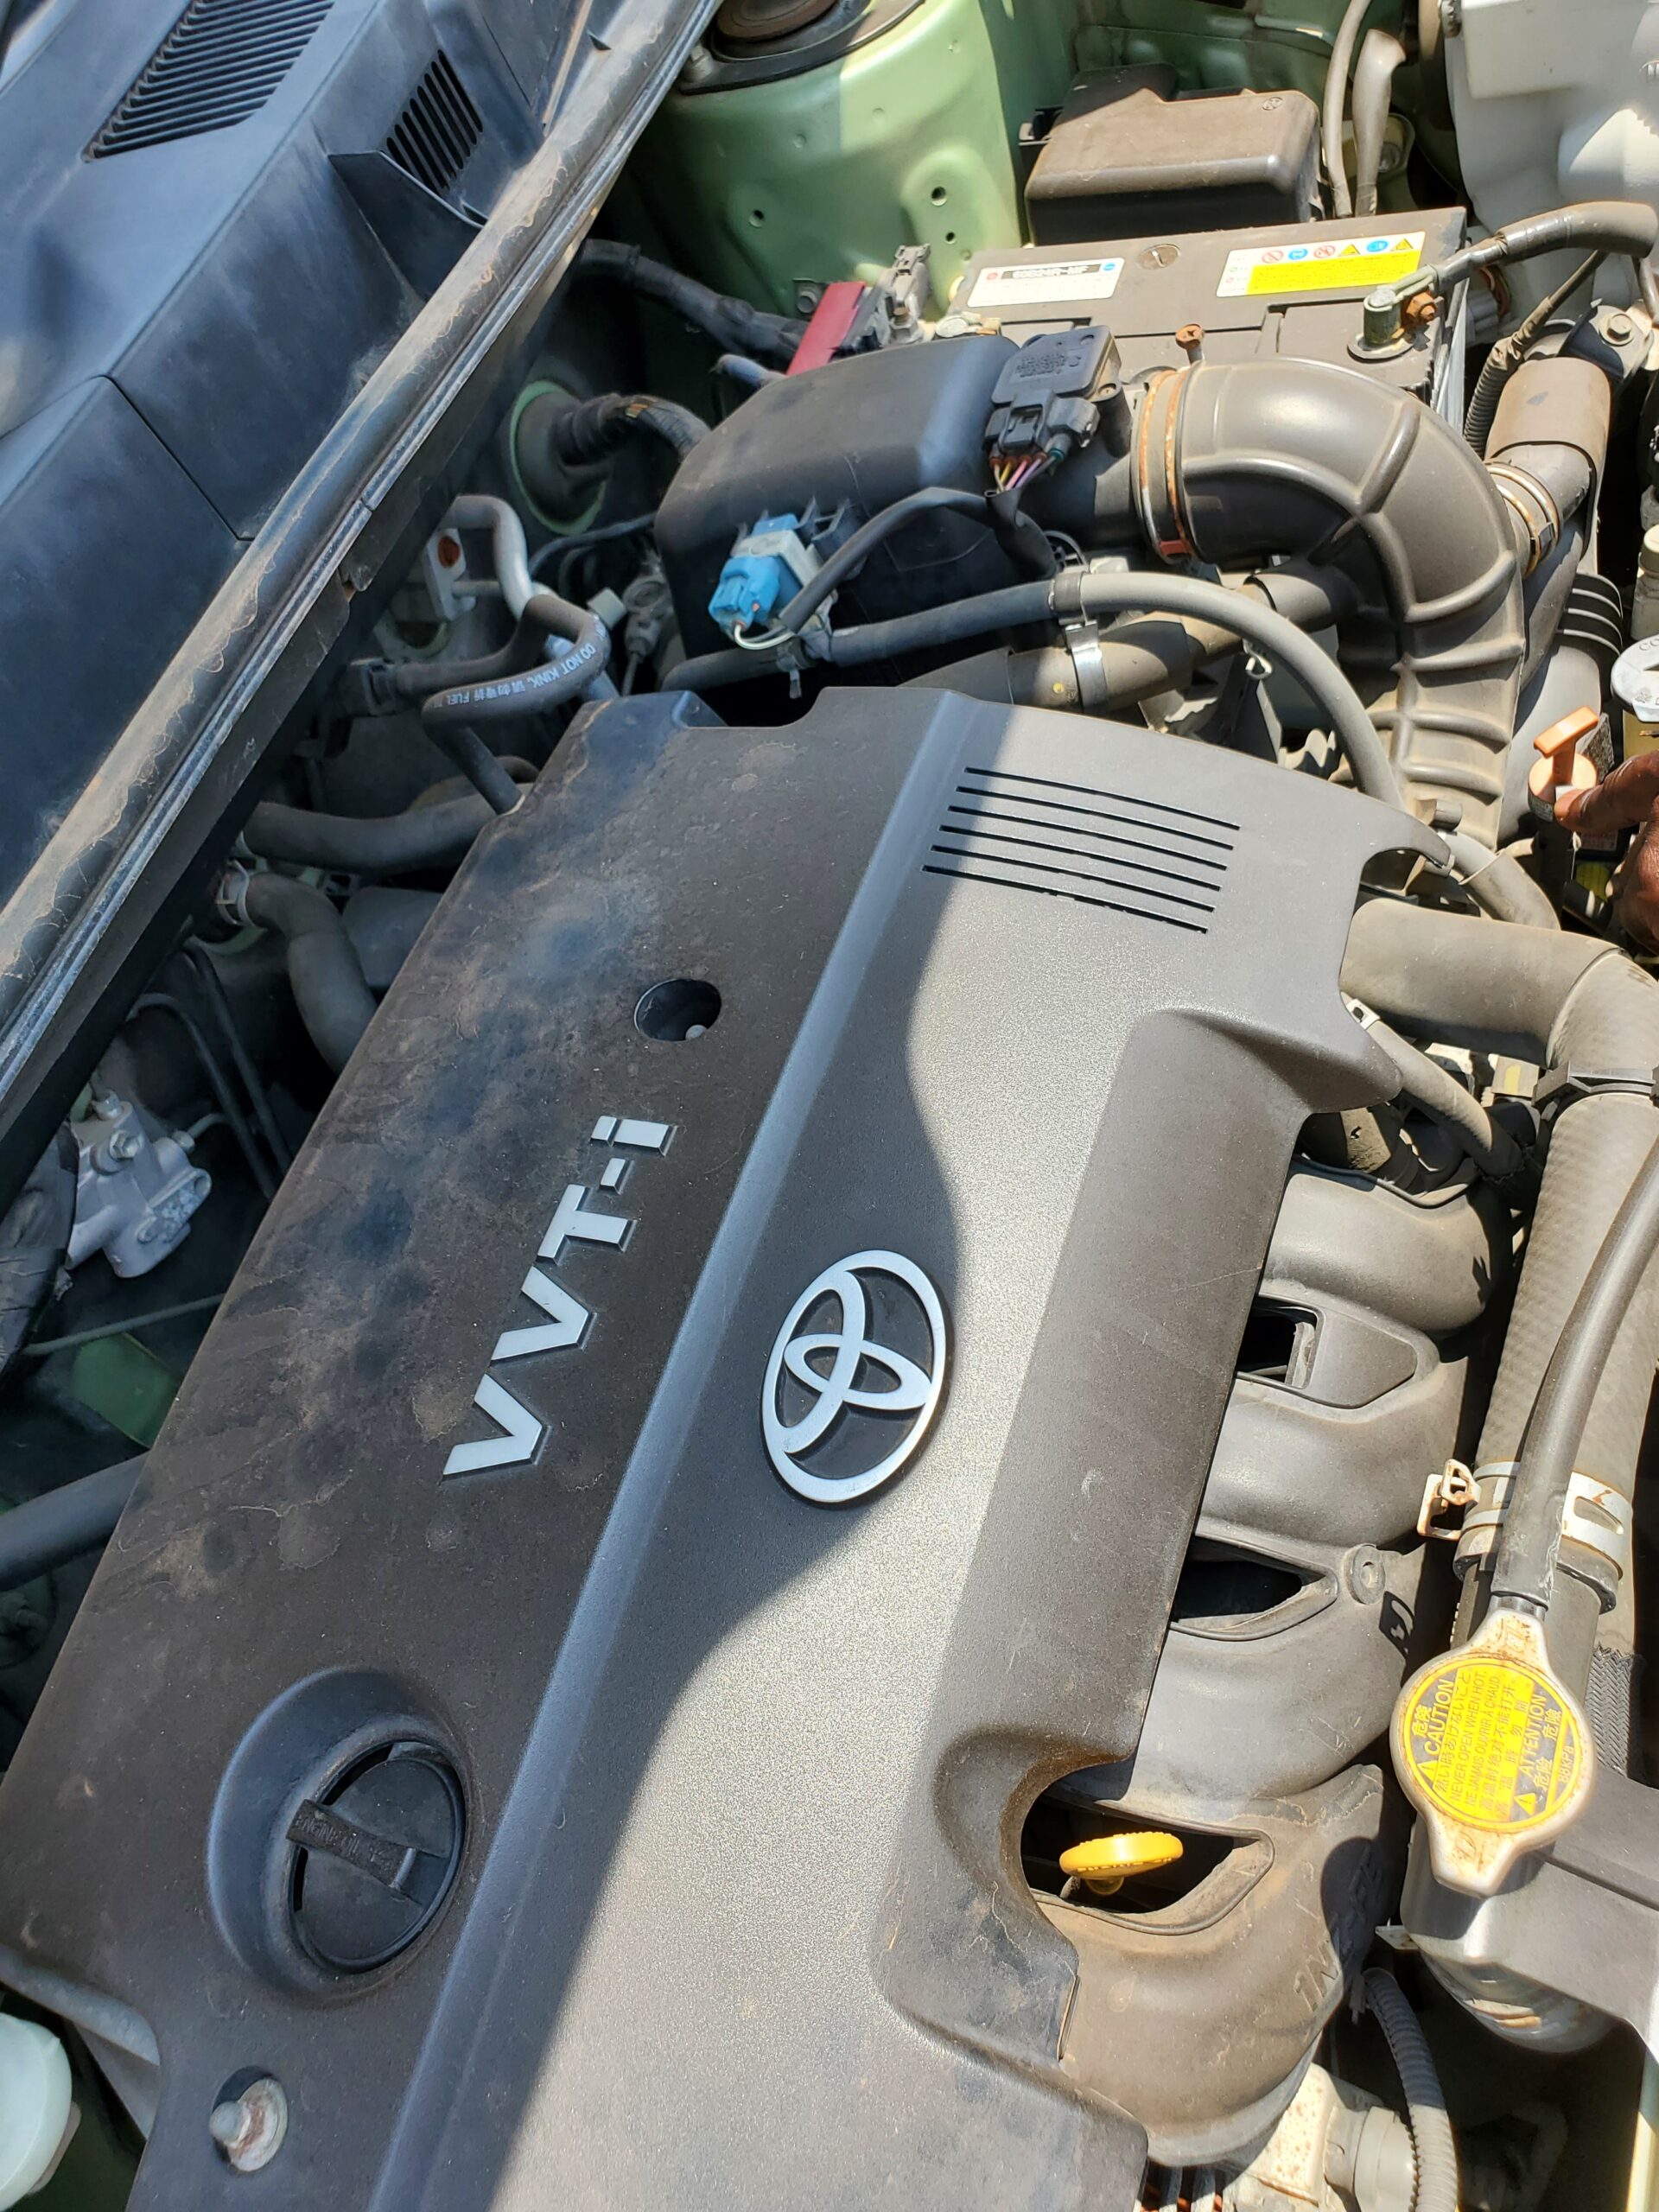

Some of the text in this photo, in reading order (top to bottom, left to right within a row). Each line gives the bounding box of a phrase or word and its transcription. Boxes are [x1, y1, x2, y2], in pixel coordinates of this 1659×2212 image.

[562, 655, 584, 676] NOT
[582, 642, 596, 659] DO
[1424, 1678, 1455, 1756] CAUTION
[1465, 1696, 1481, 1734] WHEN
[1458, 1736, 1474, 1761] OPEN
[1475, 1719, 1491, 1755] OUVRIR
[1518, 1694, 1548, 1778] ATTENTION
[1451, 1761, 1467, 1802] NEVER
[1469, 1756, 1486, 1791] JAMAIS
[1465, 1791, 1478, 1807] NE
